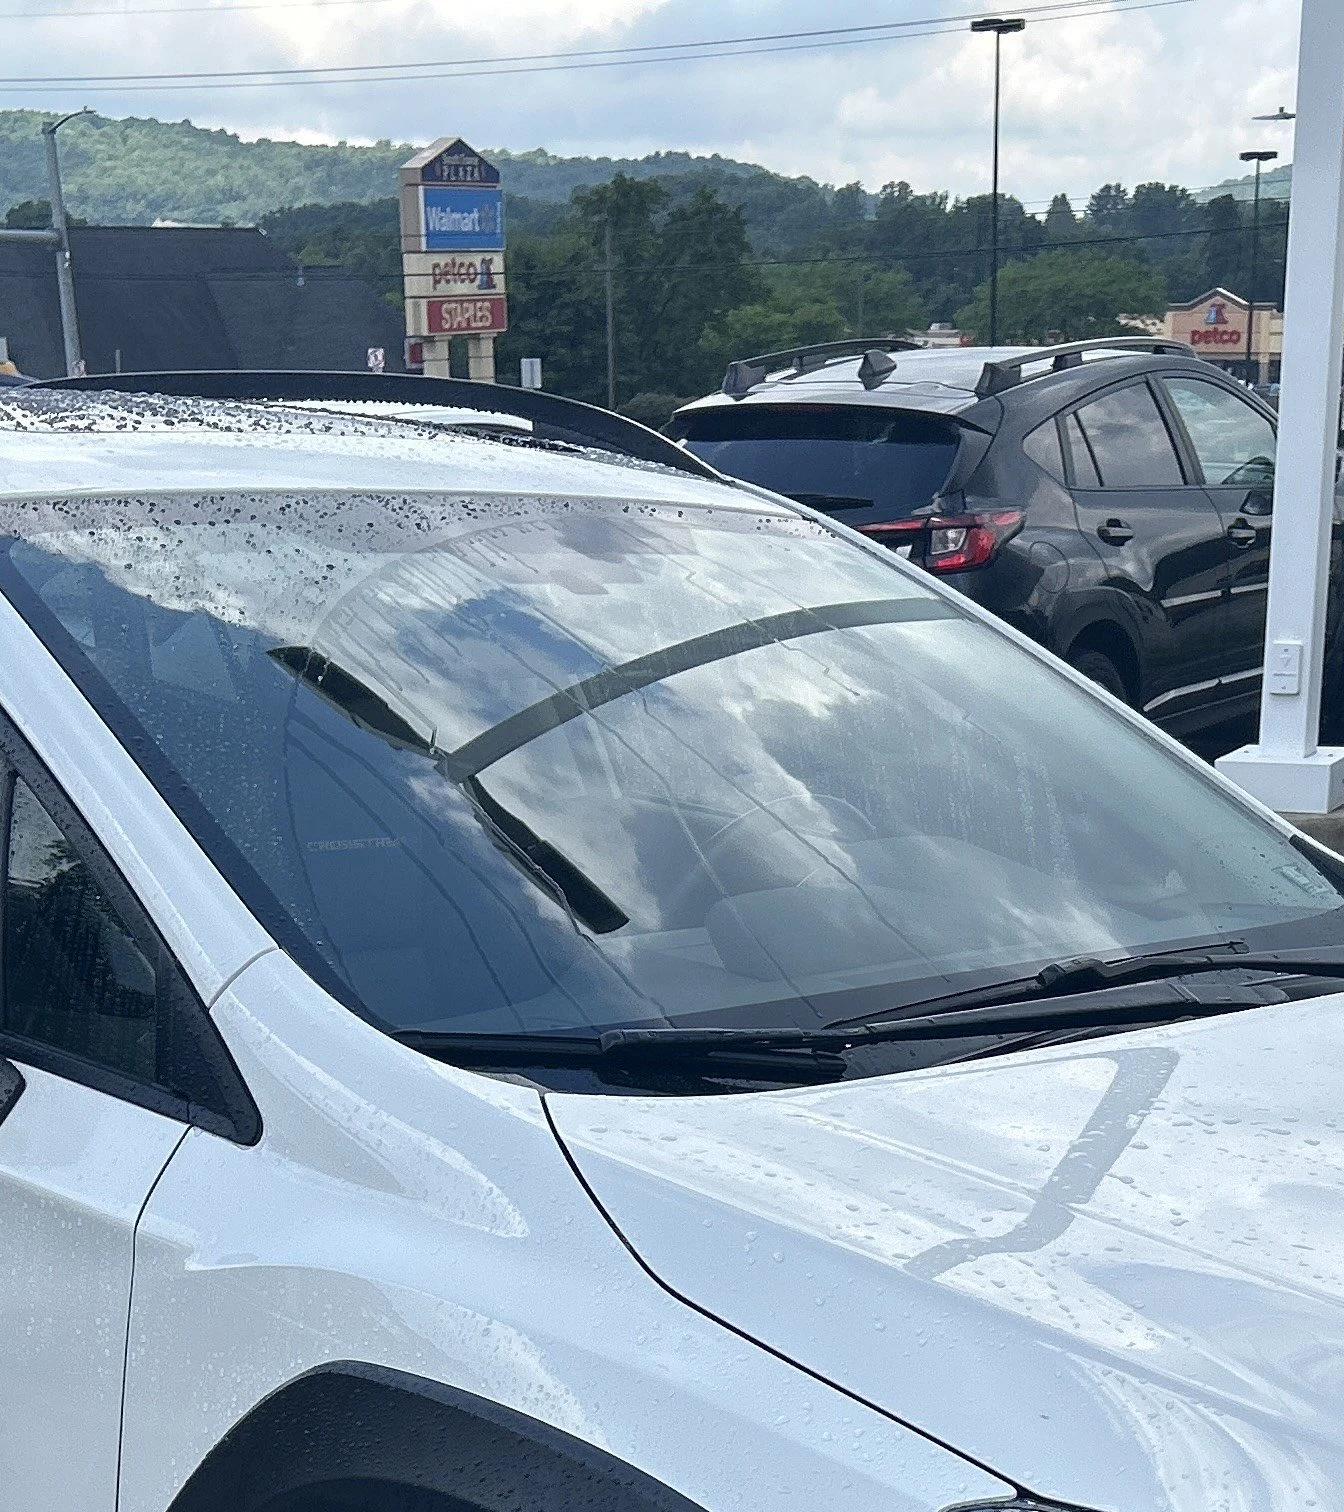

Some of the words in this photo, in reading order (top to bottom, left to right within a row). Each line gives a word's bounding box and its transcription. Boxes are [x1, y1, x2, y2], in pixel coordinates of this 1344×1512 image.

[426, 206, 479, 232] Walmart
[432, 257, 476, 291] petco
[441, 302, 492, 329] STAPLES
[1191, 327, 1241, 345] petco
